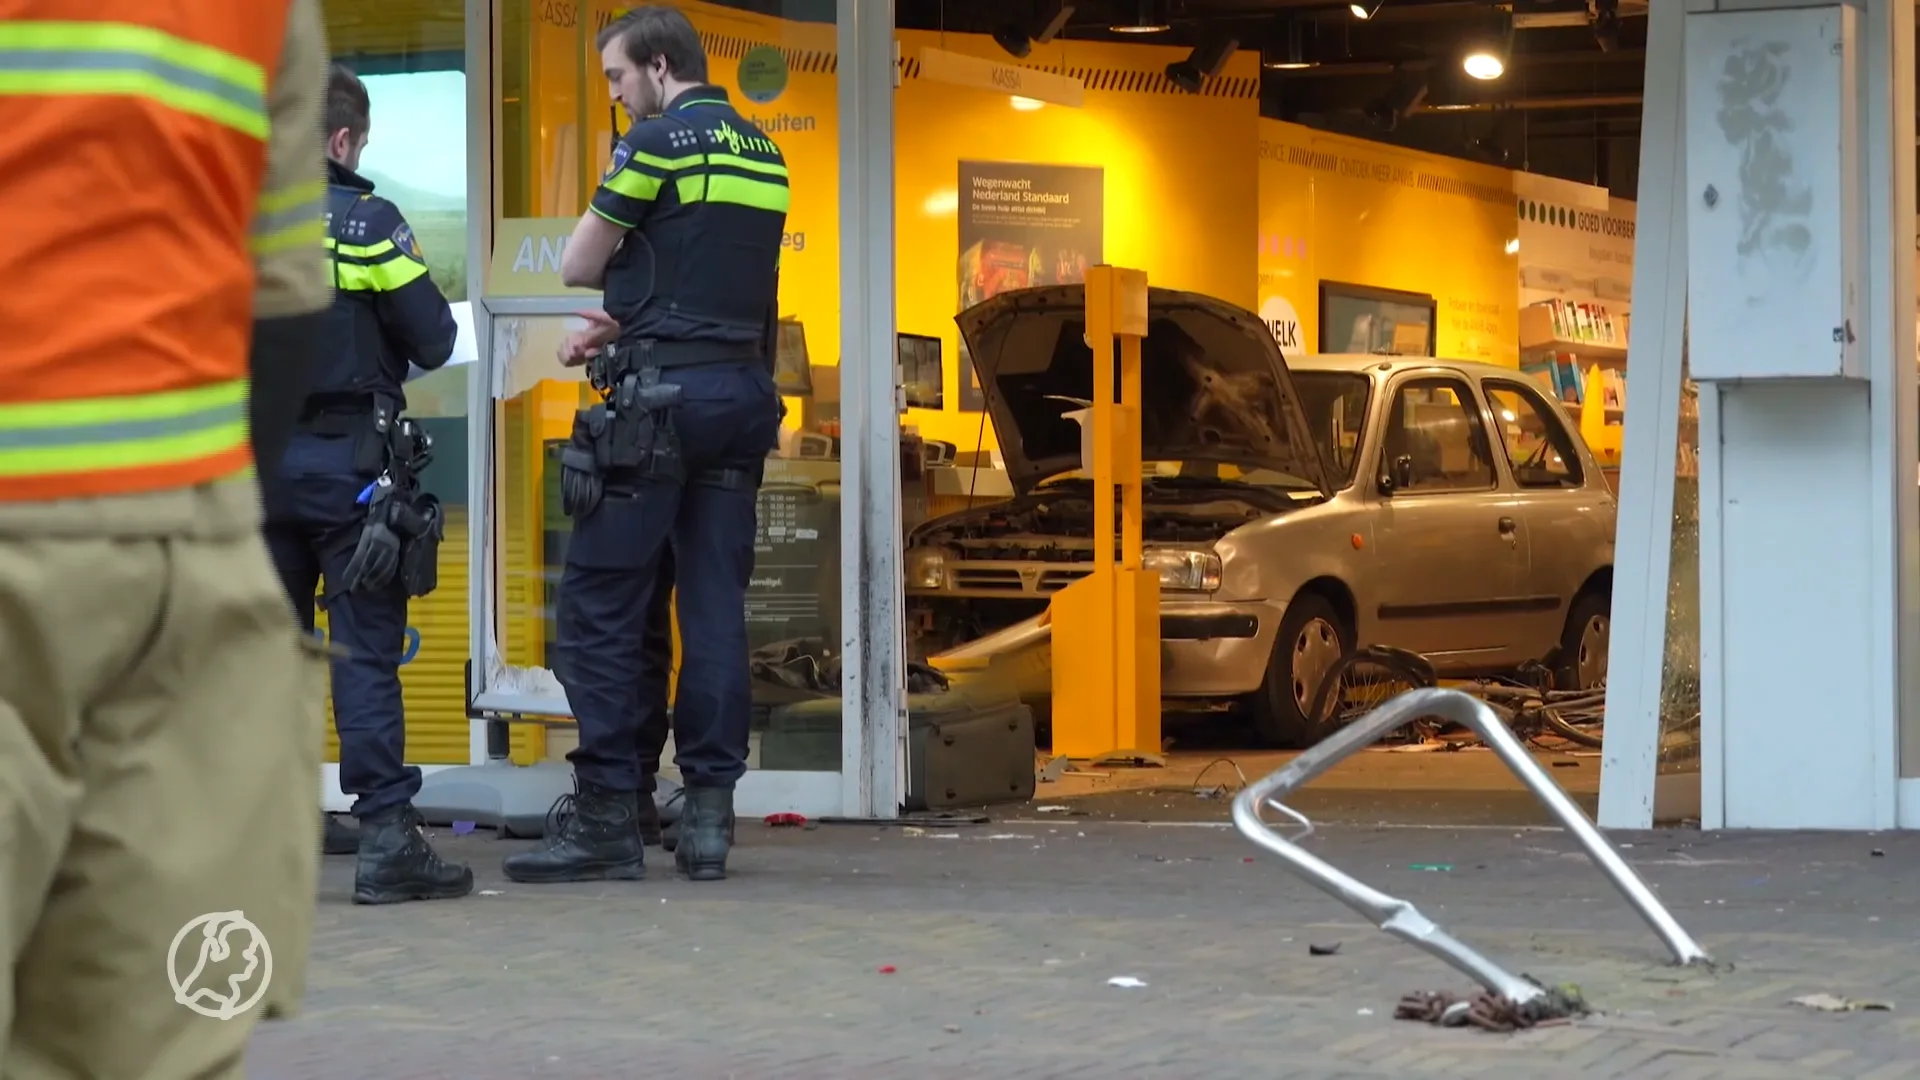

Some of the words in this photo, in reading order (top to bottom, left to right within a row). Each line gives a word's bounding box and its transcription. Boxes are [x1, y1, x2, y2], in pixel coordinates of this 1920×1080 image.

[538, 0, 578, 28] ASSA
[991, 65, 1022, 90] KASSA
[713, 126, 778, 155] POLITIE
[972, 176, 1031, 190] Wegenwacht
[972, 190, 1020, 202] Nederland
[1022, 192, 1070, 204] Standaard
[1578, 211, 1600, 233] GOED
[1601, 216, 1636, 239] VOORBER
[512, 234, 573, 273] AN
